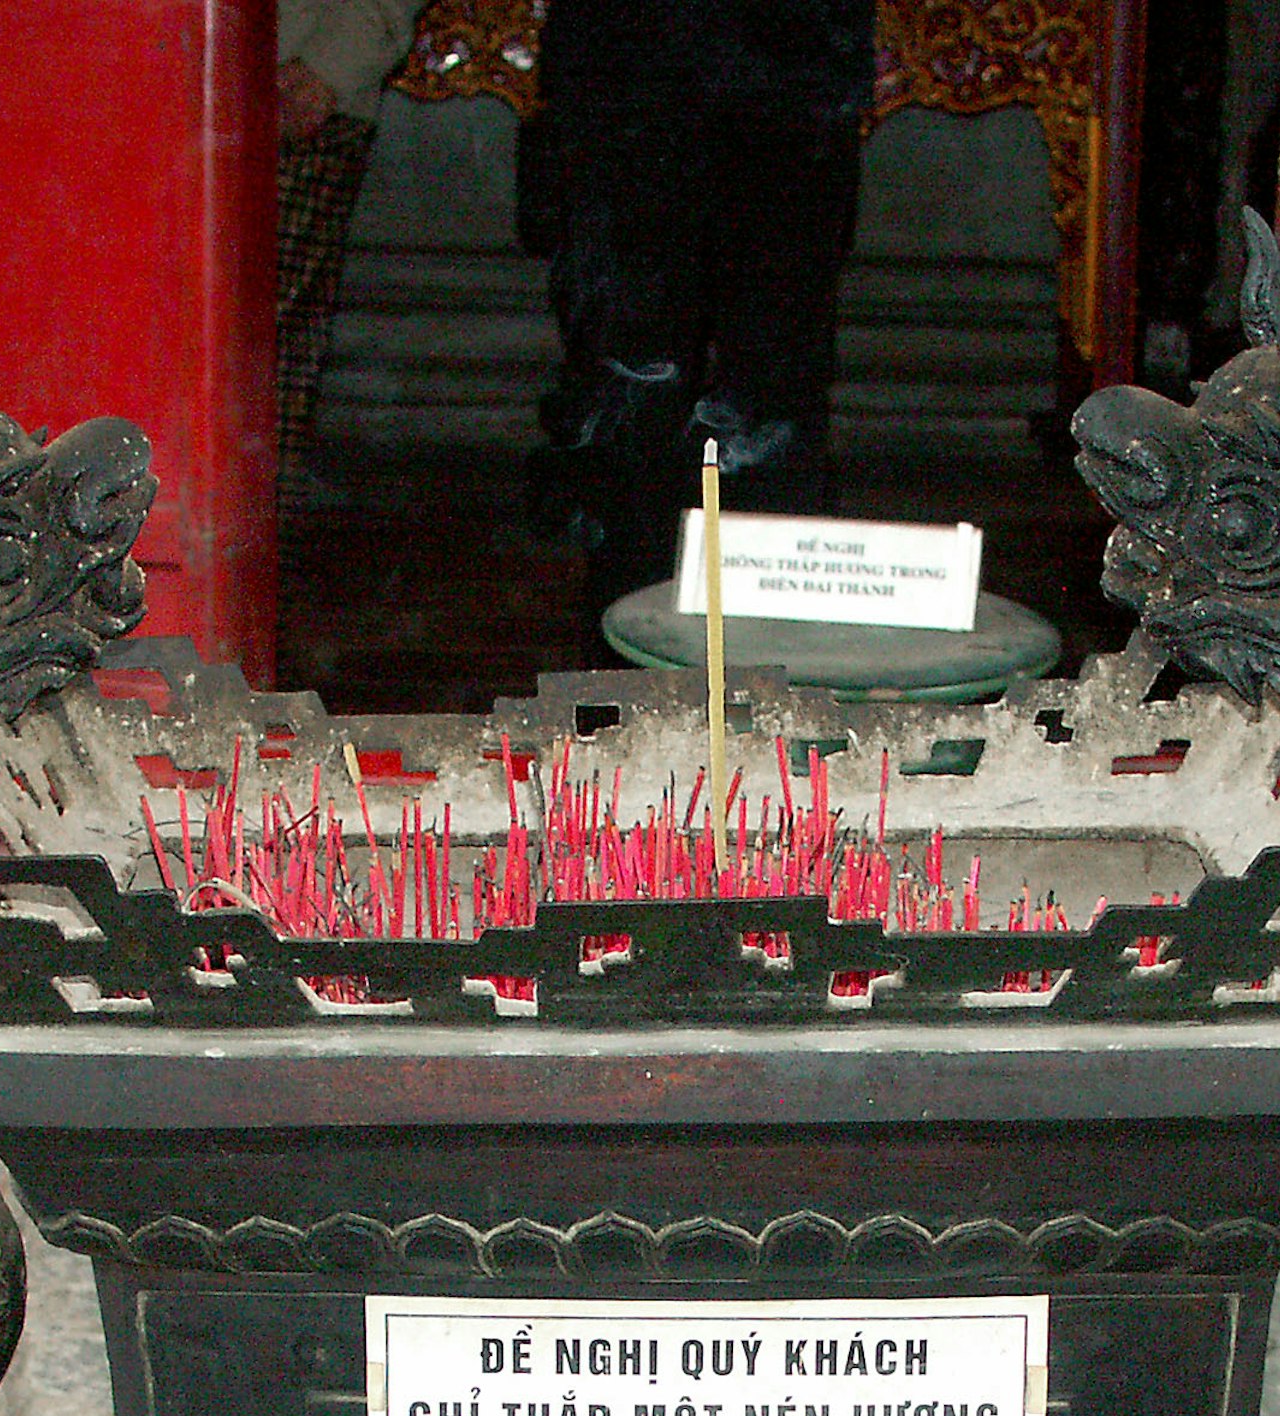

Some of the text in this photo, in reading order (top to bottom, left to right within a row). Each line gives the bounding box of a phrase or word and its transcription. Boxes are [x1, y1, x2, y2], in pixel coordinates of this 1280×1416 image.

[720, 553, 772, 570] HÔNG
[480, 1324, 928, 1385] ĐỀ NGHỊ QUÝ KHÁCH
